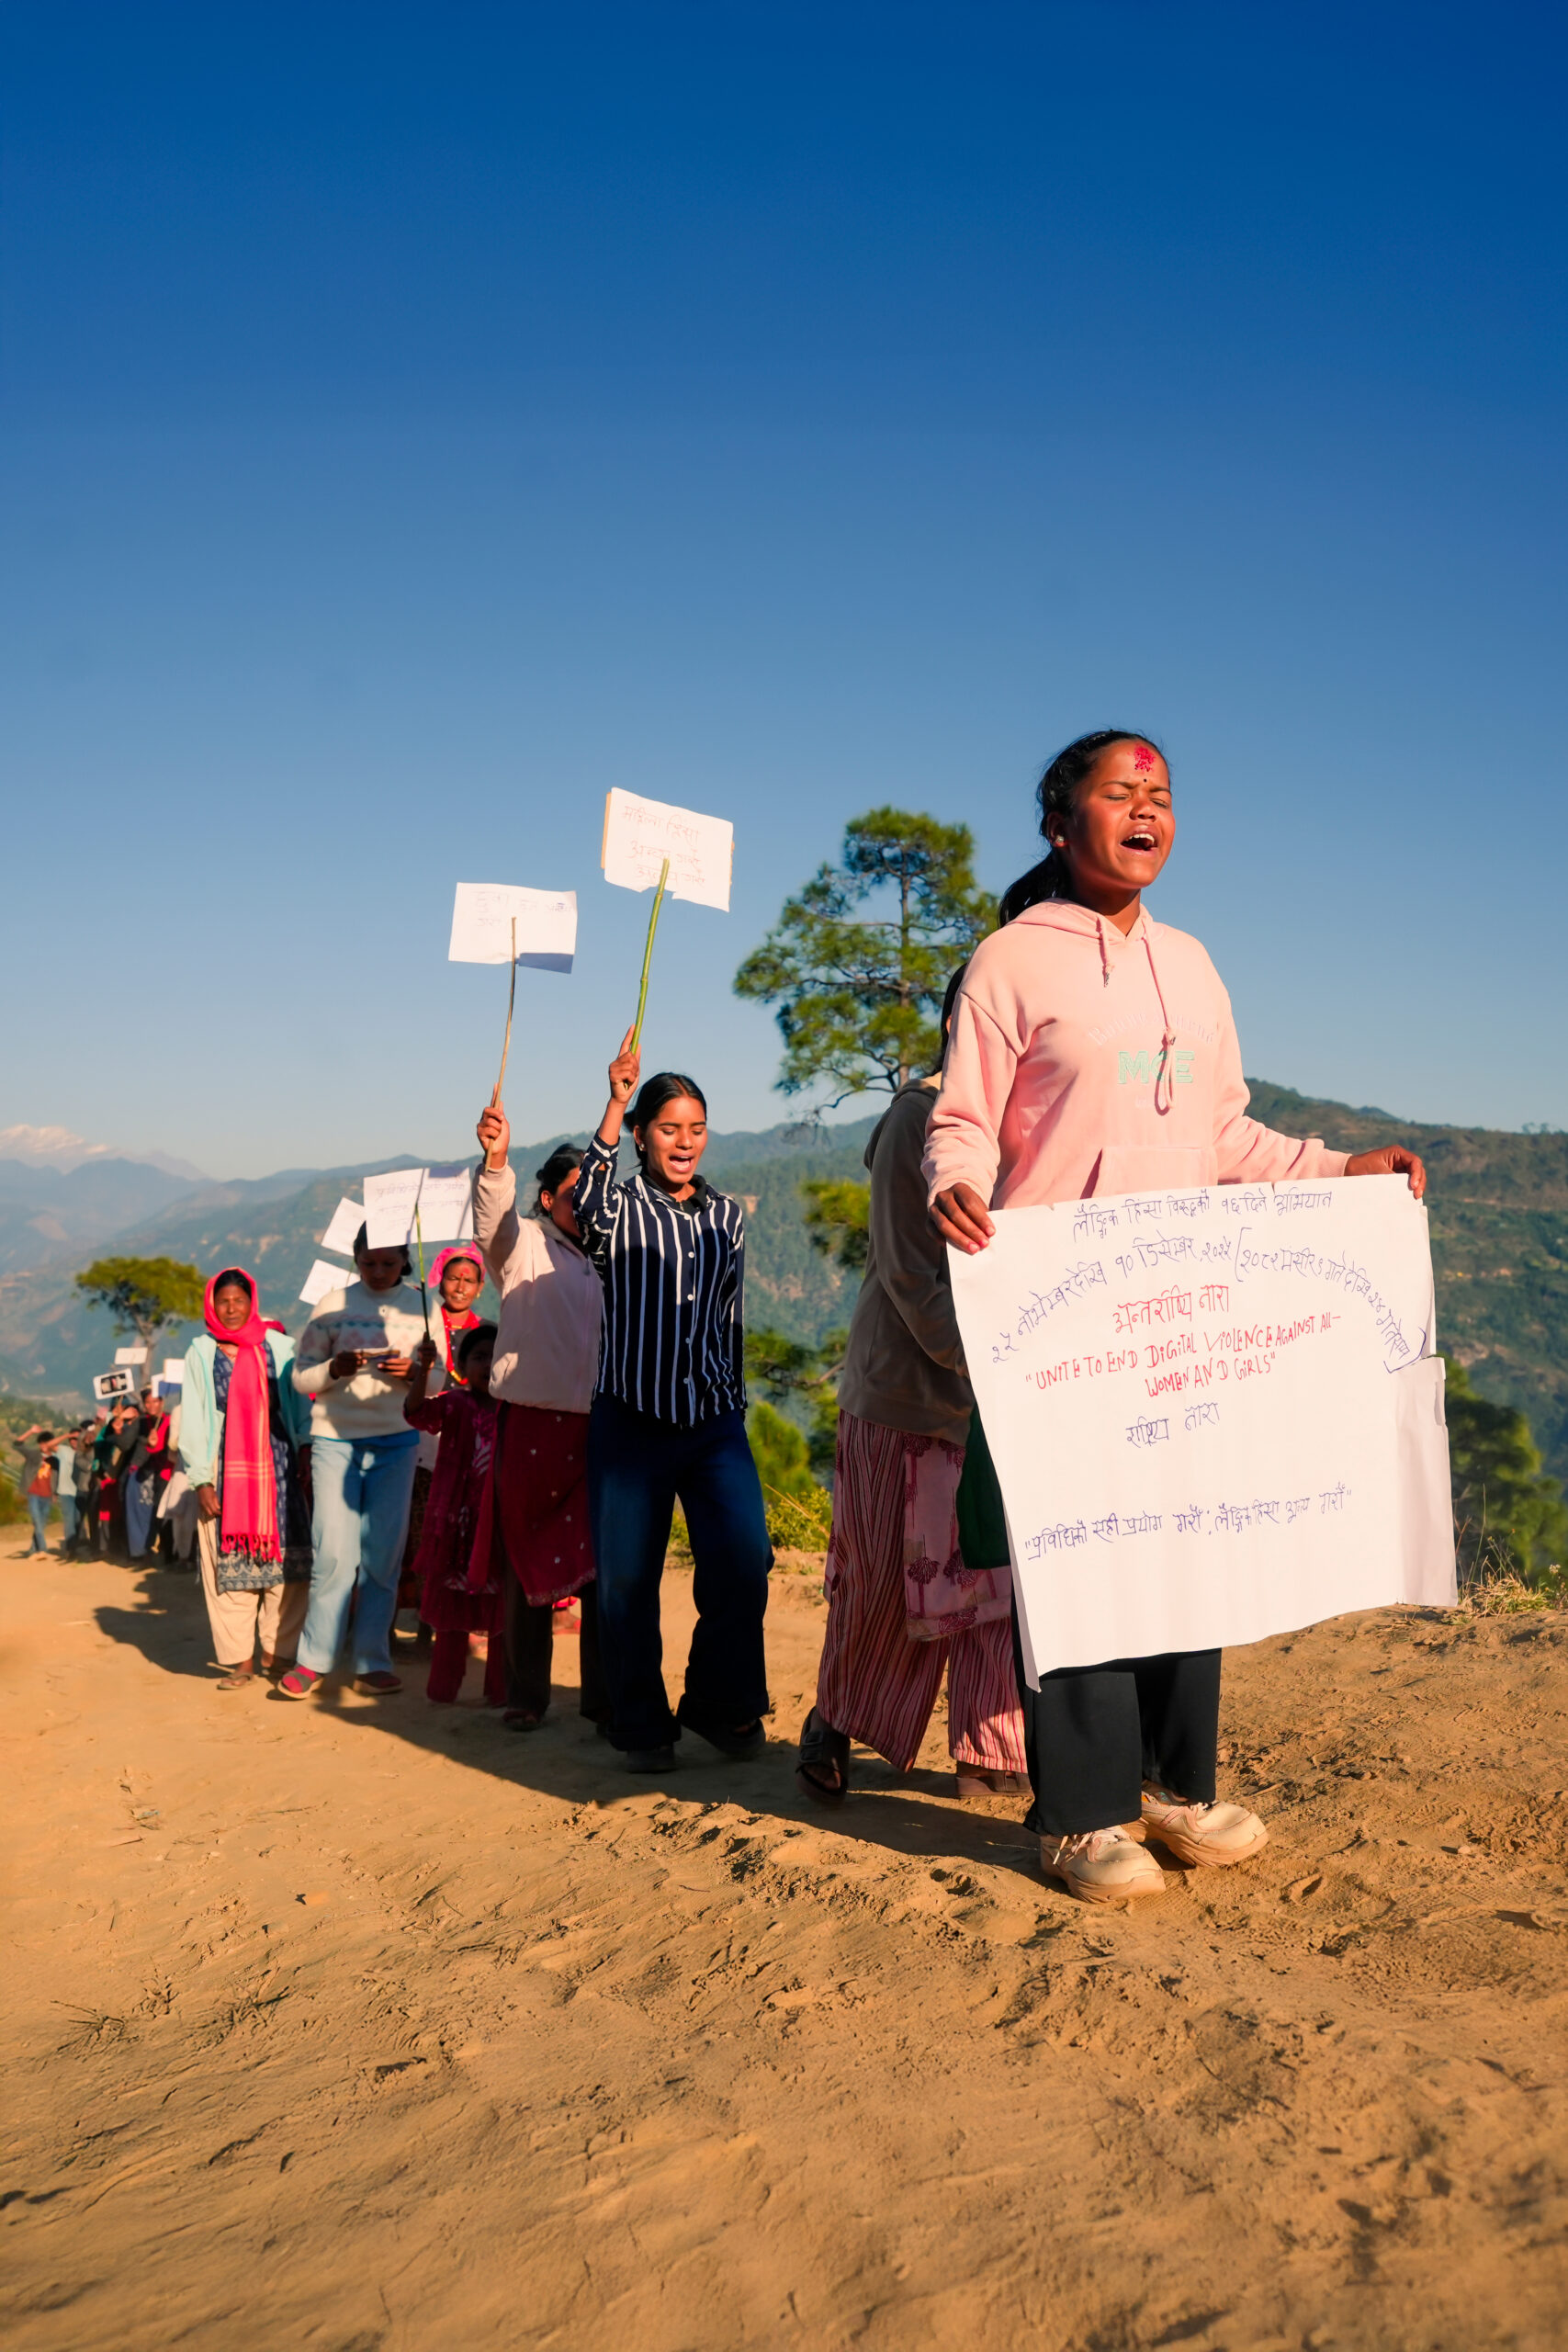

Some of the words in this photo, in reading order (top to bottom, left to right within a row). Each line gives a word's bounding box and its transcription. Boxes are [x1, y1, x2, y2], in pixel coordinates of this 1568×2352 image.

[1114, 1253, 1134, 1280] १०
[1082, 1355, 1103, 1378] TO
[1106, 1349, 1139, 1374] END
[1193, 1356, 1229, 1390] AND
